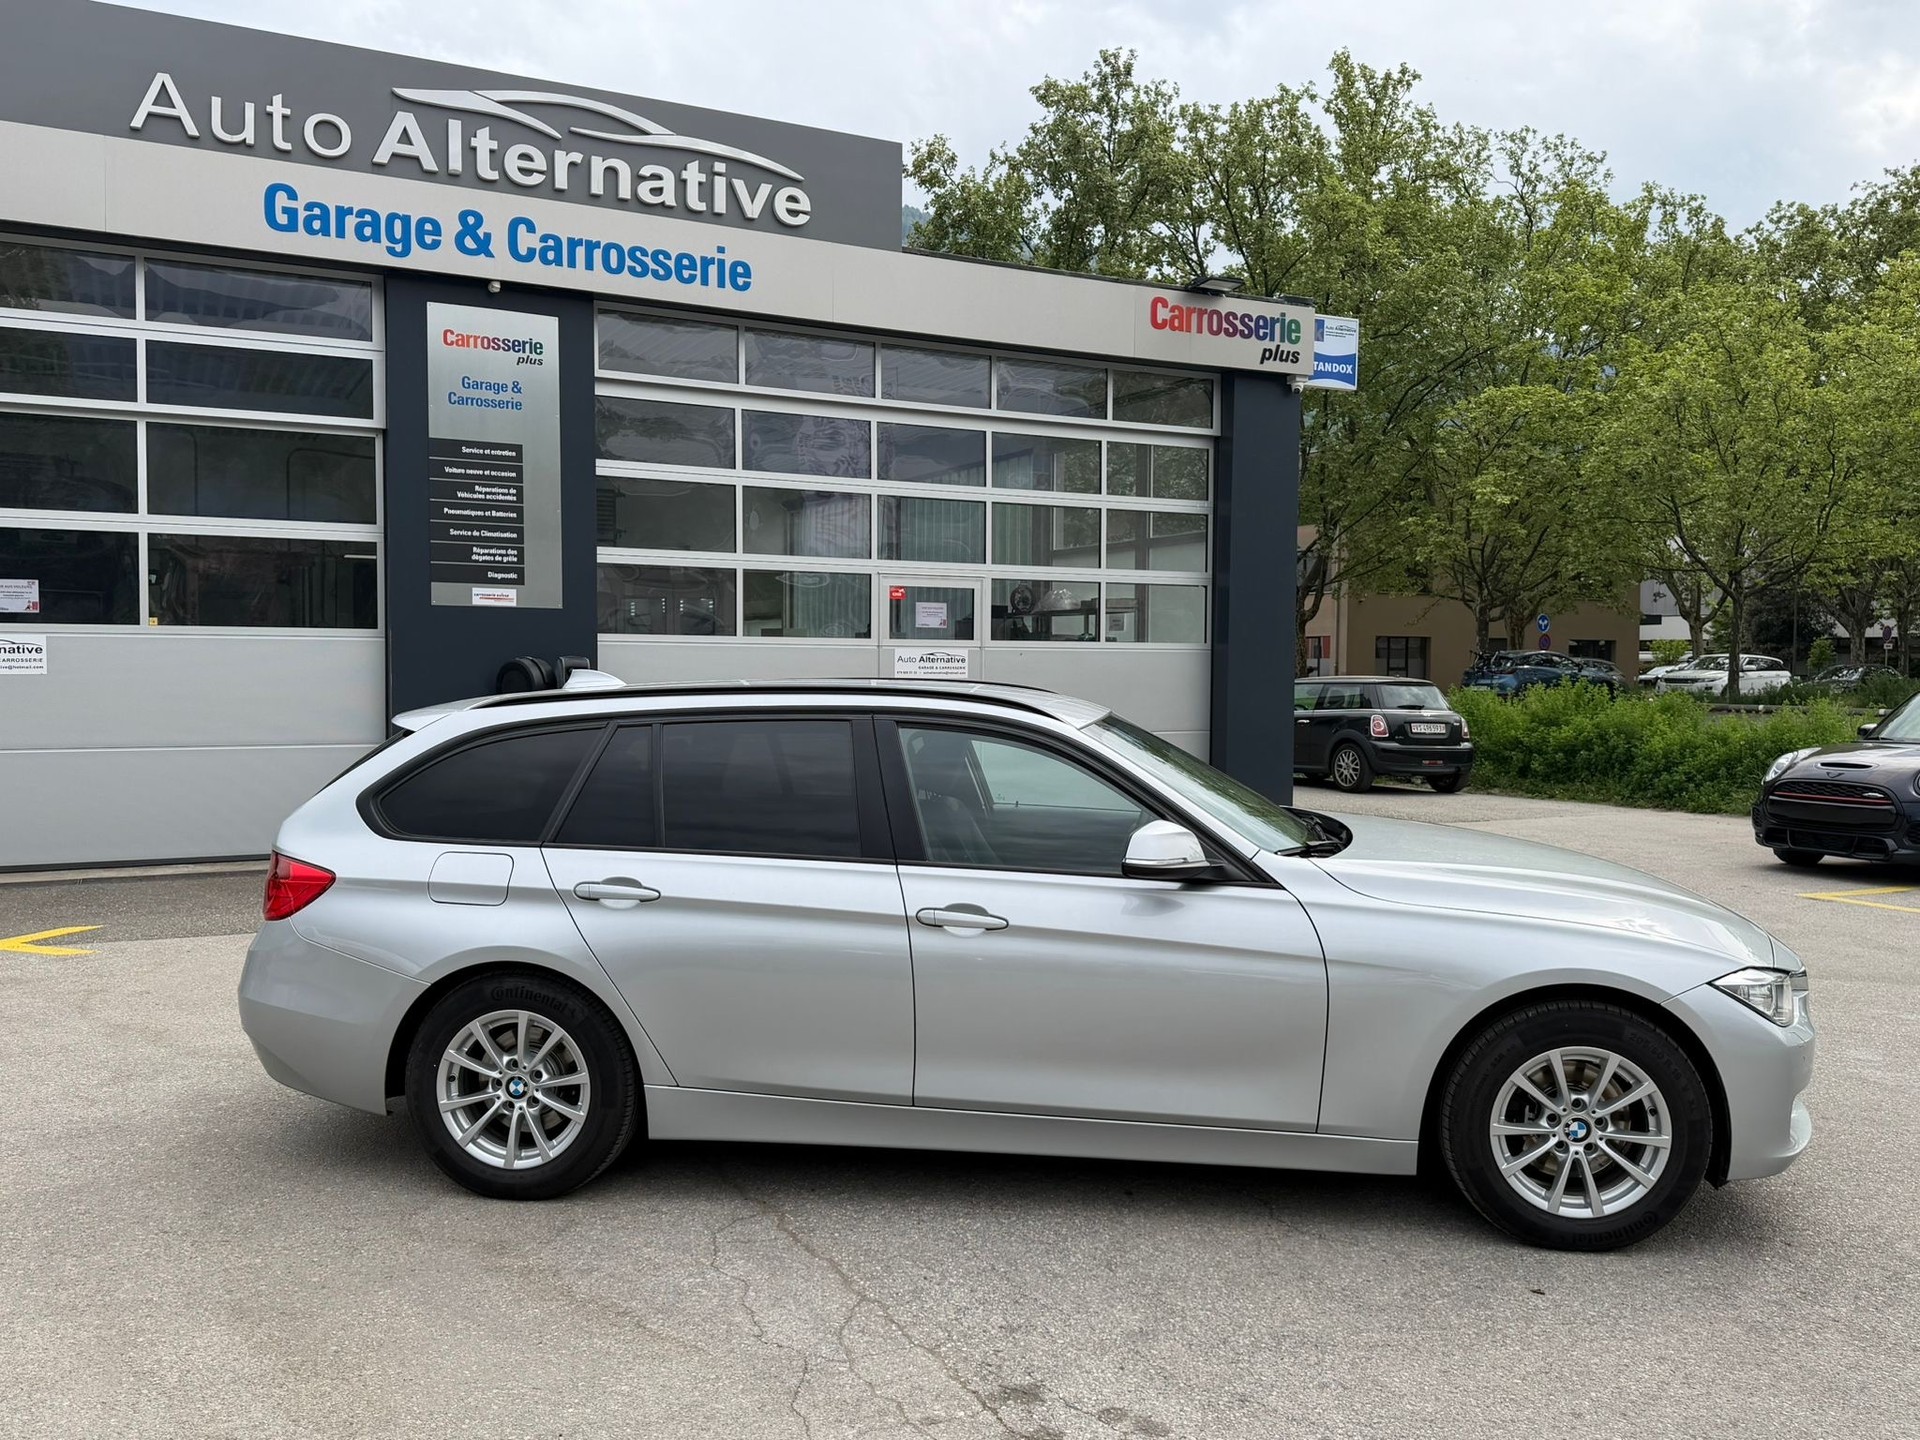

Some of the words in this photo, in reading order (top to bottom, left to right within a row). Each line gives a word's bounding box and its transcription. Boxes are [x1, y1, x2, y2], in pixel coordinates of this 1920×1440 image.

[129, 72, 352, 158] Auto
[371, 110, 812, 227] Alternative
[263, 182, 442, 258] Garage
[454, 209, 495, 259] &
[507, 216, 752, 292] Carrosserie
[1150, 297, 1301, 345] Carrosserie
[442, 329, 544, 356] Carrosserie
[1260, 344, 1300, 365] plus
[517, 355, 544, 366] plus
[1314, 361, 1353, 374] TANDOX
[461, 376, 508, 395] Garage
[511, 381, 522, 394] &
[447, 391, 522, 411] Carrosserie
[461, 446, 483, 454] Service
[444, 466, 465, 474] Voiture
[457, 491, 485, 499] Véhicules
[475, 485, 508, 494] Réparations
[443, 507, 484, 516] Pneumatiques
[492, 510, 517, 518] Batteries
[481, 530, 517, 538] Climatisation
[472, 547, 506, 555] Réparations
[488, 572, 518, 580] Diagnostic
[897, 655, 917, 663] Auto
[918, 656, 966, 664] Alternative
